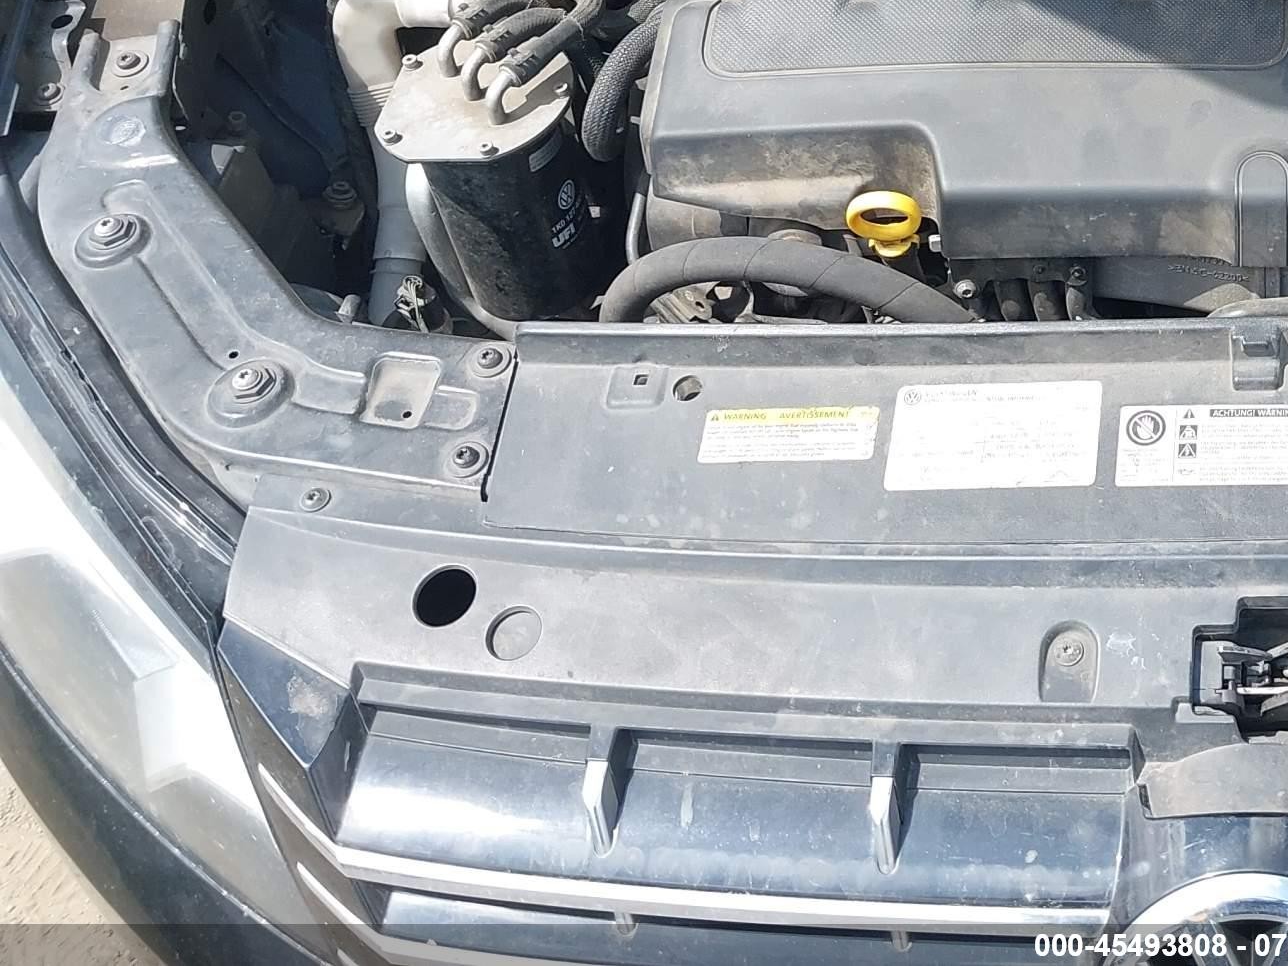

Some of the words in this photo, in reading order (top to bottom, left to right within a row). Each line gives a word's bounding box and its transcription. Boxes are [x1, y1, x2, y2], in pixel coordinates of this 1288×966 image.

[552, 222, 576, 248] UFI
[724, 413, 767, 421] WARNING
[778, 410, 850, 420] AVERTISSEMENT
[1212, 408, 1255, 418] ACHTUNG!
